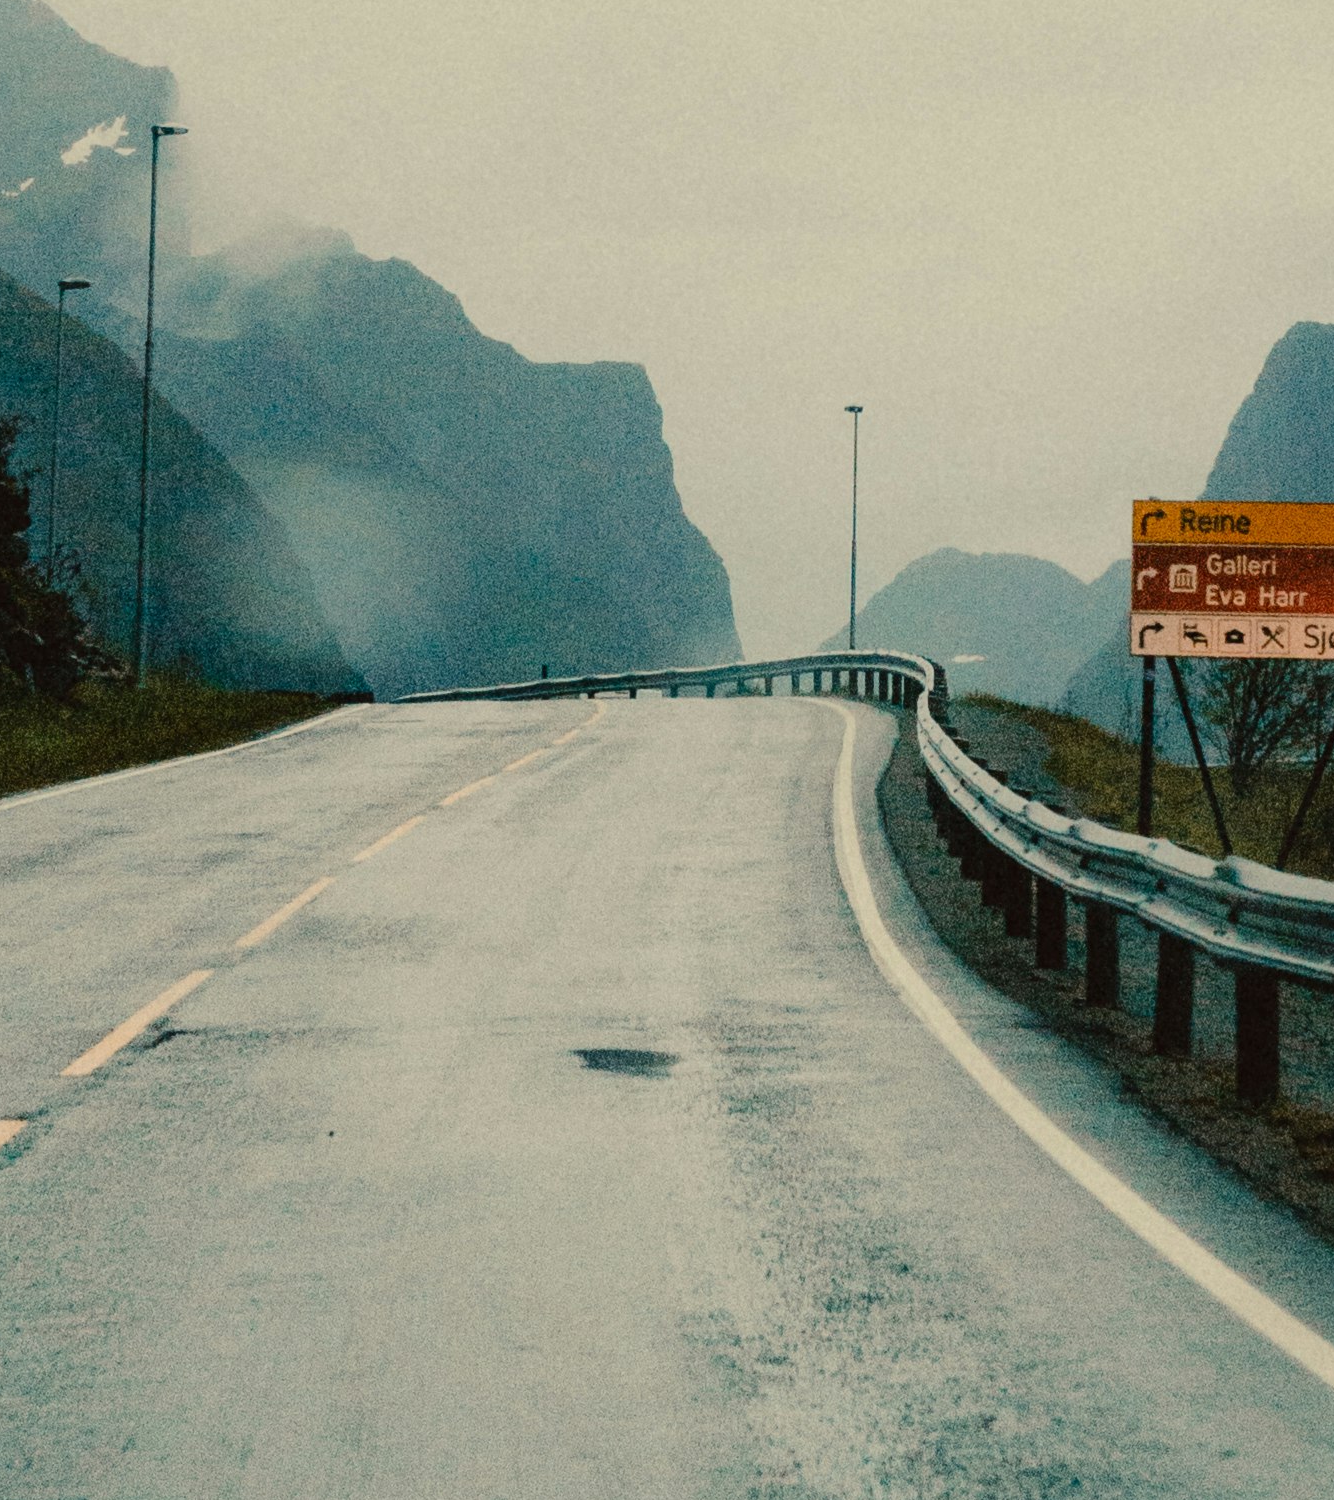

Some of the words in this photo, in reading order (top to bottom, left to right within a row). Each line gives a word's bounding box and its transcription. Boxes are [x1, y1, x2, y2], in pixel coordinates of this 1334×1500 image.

[1179, 508, 1252, 534] Reine
[1206, 553, 1277, 577] Galleri
[1205, 585, 1246, 606] Eva
[1259, 586, 1309, 607] Harr
